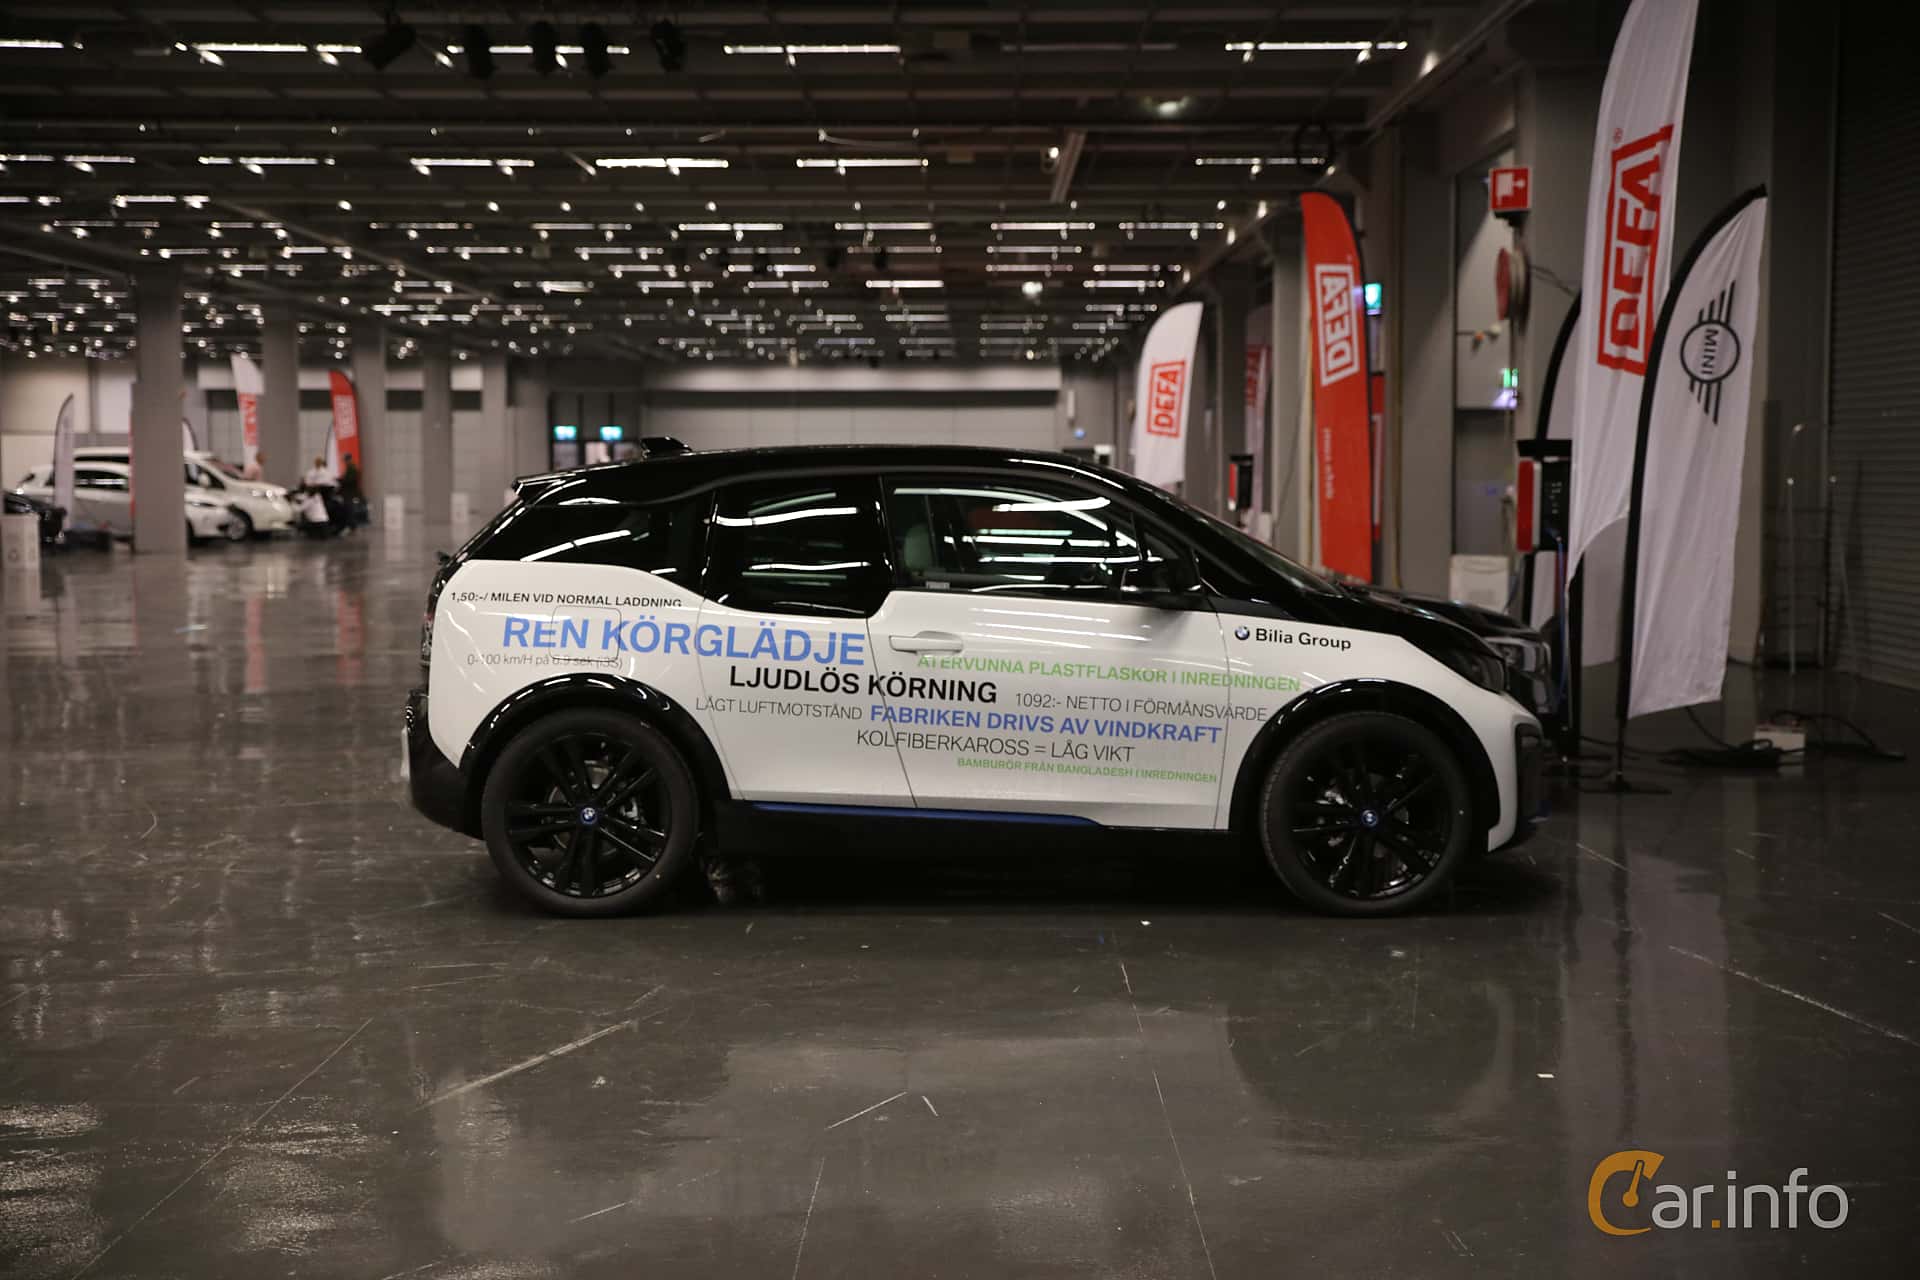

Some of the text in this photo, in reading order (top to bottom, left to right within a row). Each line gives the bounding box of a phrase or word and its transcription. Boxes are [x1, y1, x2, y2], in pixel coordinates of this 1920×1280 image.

[1610, 154, 1661, 350] DEFA
[1323, 275, 1352, 371] DEFA
[1701, 328, 1719, 375] MINI
[1154, 370, 1178, 428] DEFA
[491, 592, 530, 602] MILEN
[533, 593, 554, 603] VID
[557, 594, 611, 606] NORMAL
[616, 596, 682, 608] LADDNING
[503, 615, 865, 666] REN KÖRGLÄDJE
[1256, 628, 1351, 651] Bilia Group
[536, 654, 549, 668] på
[1029, 661, 1167, 683] PLASTFLASKOR
[1172, 672, 1177, 683] I
[1182, 672, 1300, 691] INREDNINGEN
[730, 665, 997, 704] LJUDLÖS KÖRNING
[696, 695, 1222, 744] LÅGT LUFTMOTSTÅND FABRIKEN DRIVS AV VINDKRAFT
[1016, 693, 1061, 708] 1092:-
[1066, 695, 1121, 712] NETTO
[1133, 698, 1268, 722] FÖRMÅNSVÄRDE
[857, 729, 1029, 756] KOLFIBERKAROSS
[1051, 740, 1088, 760] LÅG
[1093, 744, 1136, 762] VIKT
[1056, 763, 1133, 777] BANGLADESH
[1141, 768, 1217, 783] INREDNINGEN
